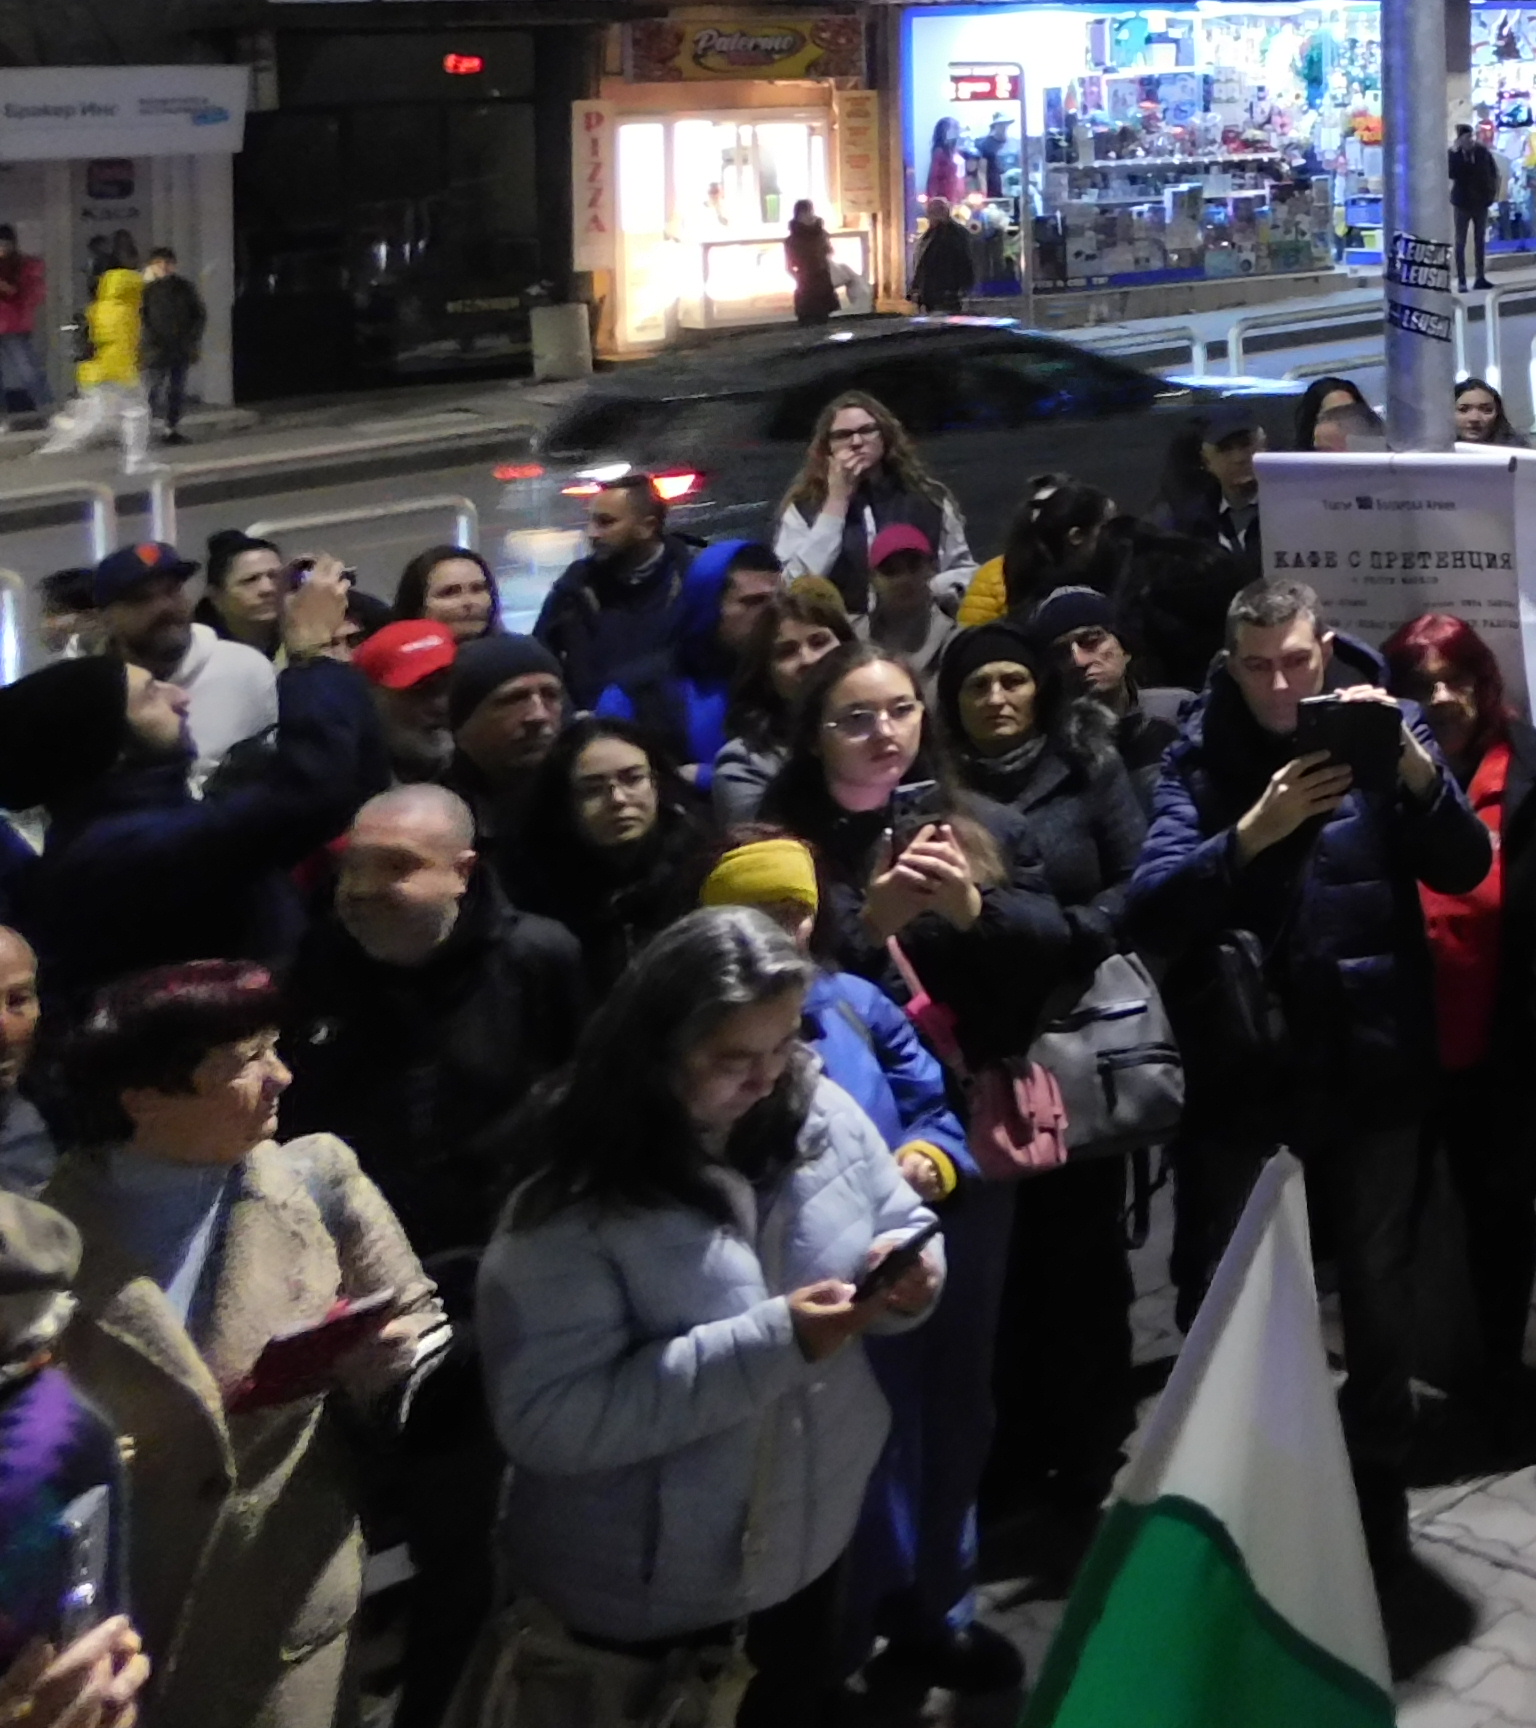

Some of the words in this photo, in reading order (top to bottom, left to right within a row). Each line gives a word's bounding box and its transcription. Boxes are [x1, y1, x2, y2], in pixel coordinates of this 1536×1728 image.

[694, 27, 796, 55] Palermo
[584, 111, 607, 233] PIZZA
[1273, 550, 1338, 569] КАФЕ
[1348, 550, 1361, 569] С
[1370, 550, 1513, 572] ПРЕТЕНЦИЯ
